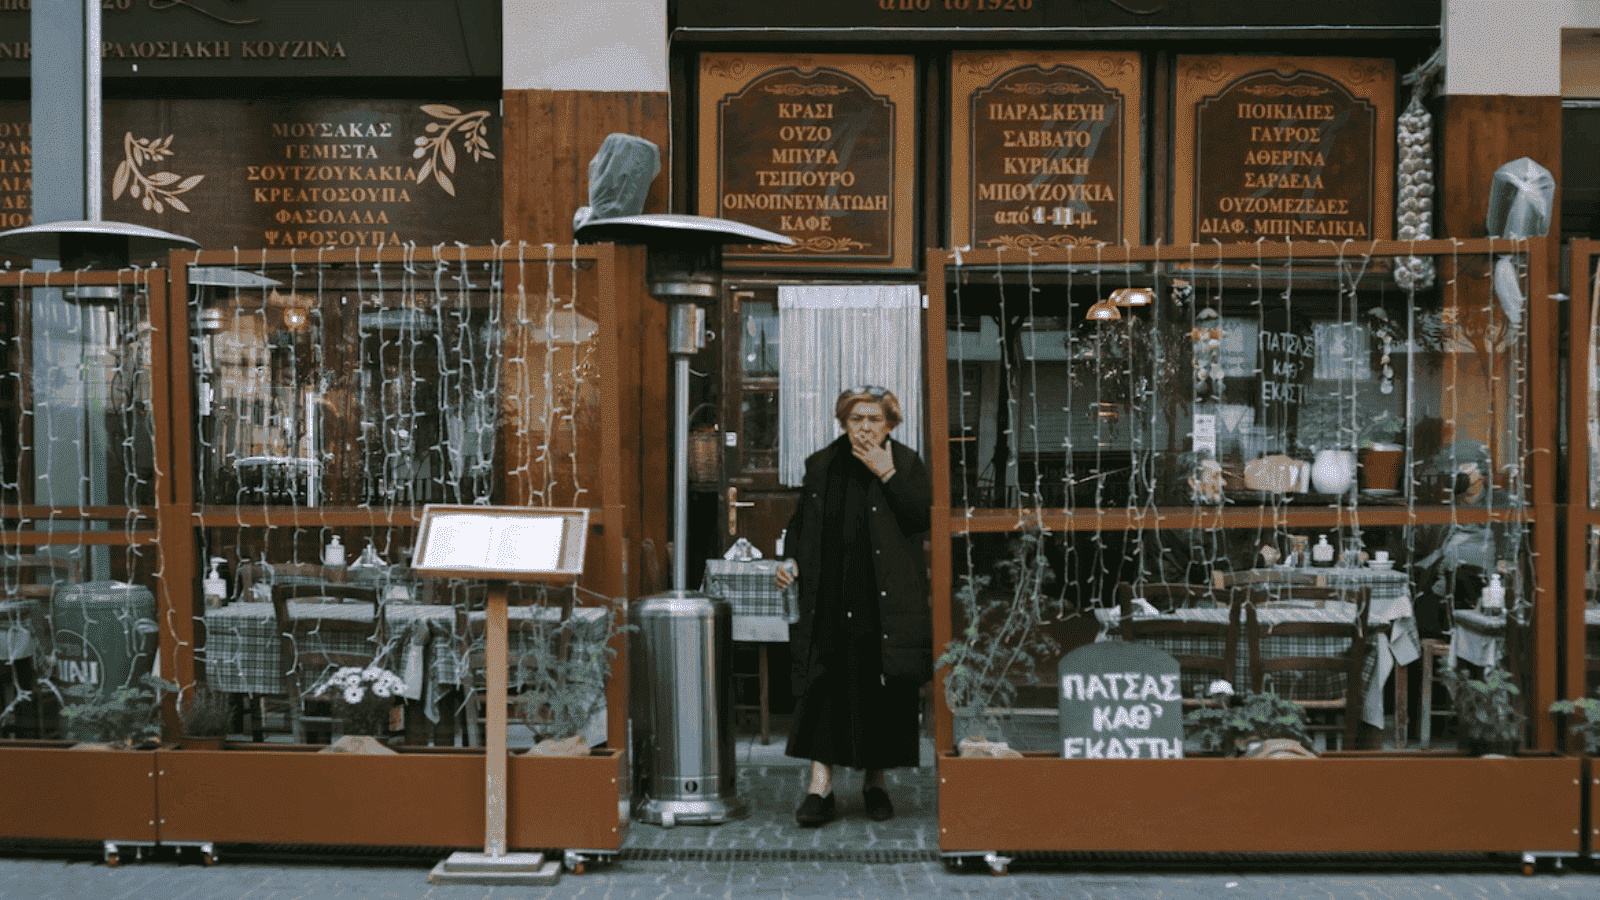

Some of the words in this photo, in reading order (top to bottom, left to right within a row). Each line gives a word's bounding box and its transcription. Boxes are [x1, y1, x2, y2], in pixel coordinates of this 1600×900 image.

[101, 41, 230, 59] ΡΑΔΟΣΙΑΚΗ
[242, 41, 347, 59] ΚΟΥΖΙΝΑ
[778, 103, 834, 119] ΚΡΑΣΙ
[989, 103, 1105, 121] ΠΑΡΑΣΚΕΥΗ
[1237, 103, 1335, 120] ΠΟΙΚΙΛΙΕΣ
[272, 122, 392, 138] ΜΟΥΣΑΚΑΣ
[779, 126, 832, 141] ΟΥΖΟ
[1003, 130, 1092, 147] ΣΑΒΒΑΤΟ
[1251, 126, 1321, 143] ΓΑΥΡΟΣ
[286, 144, 379, 159] ΓΕΜΙΣΤΑ
[772, 148, 839, 164] ΜΠΥΡΑ
[1244, 150, 1326, 167] ΑΘΕΡΙΝΑ
[246, 165, 418, 181] ΣΟΥΤΖΟΥΚΑΚΙΑ
[1004, 157, 1090, 175] ΚΥΡΙΑΚΗ
[756, 171, 855, 187] ΤΣΙΠΟΥΡΟ
[1244, 172, 1325, 189] ΣΑΡΔΕΛΑ
[254, 187, 412, 202] ΚΡΕΑΤΟΣΟΥΠΑ
[978, 183, 1115, 201] ΜΠΟΥΖΟΥΚΙΑ
[723, 194, 888, 211] ΟΙΝΟΠΝΕΥΜΑΤΩΔΗ
[1219, 197, 1349, 215] ΟΥΖΟΜΕΖΕΔΕΣ
[275, 209, 390, 224] ΦΑΣΟΛΑΔΑ
[780, 215, 832, 231] ΚΑΦΕ
[994, 205, 1030, 225] από
[1200, 218, 1250, 234] ΔΙΑΦ.
[1253, 219, 1367, 236] ΜΠΙΝΕΛΙΚΙΑ
[264, 231, 401, 246] ΨΑΡΟΣΟΥΠΑ
[1062, 672, 1182, 702] ΠΑΤΣΑΣ
[1064, 737, 1183, 759] ΕΚΑΣΤΗ
